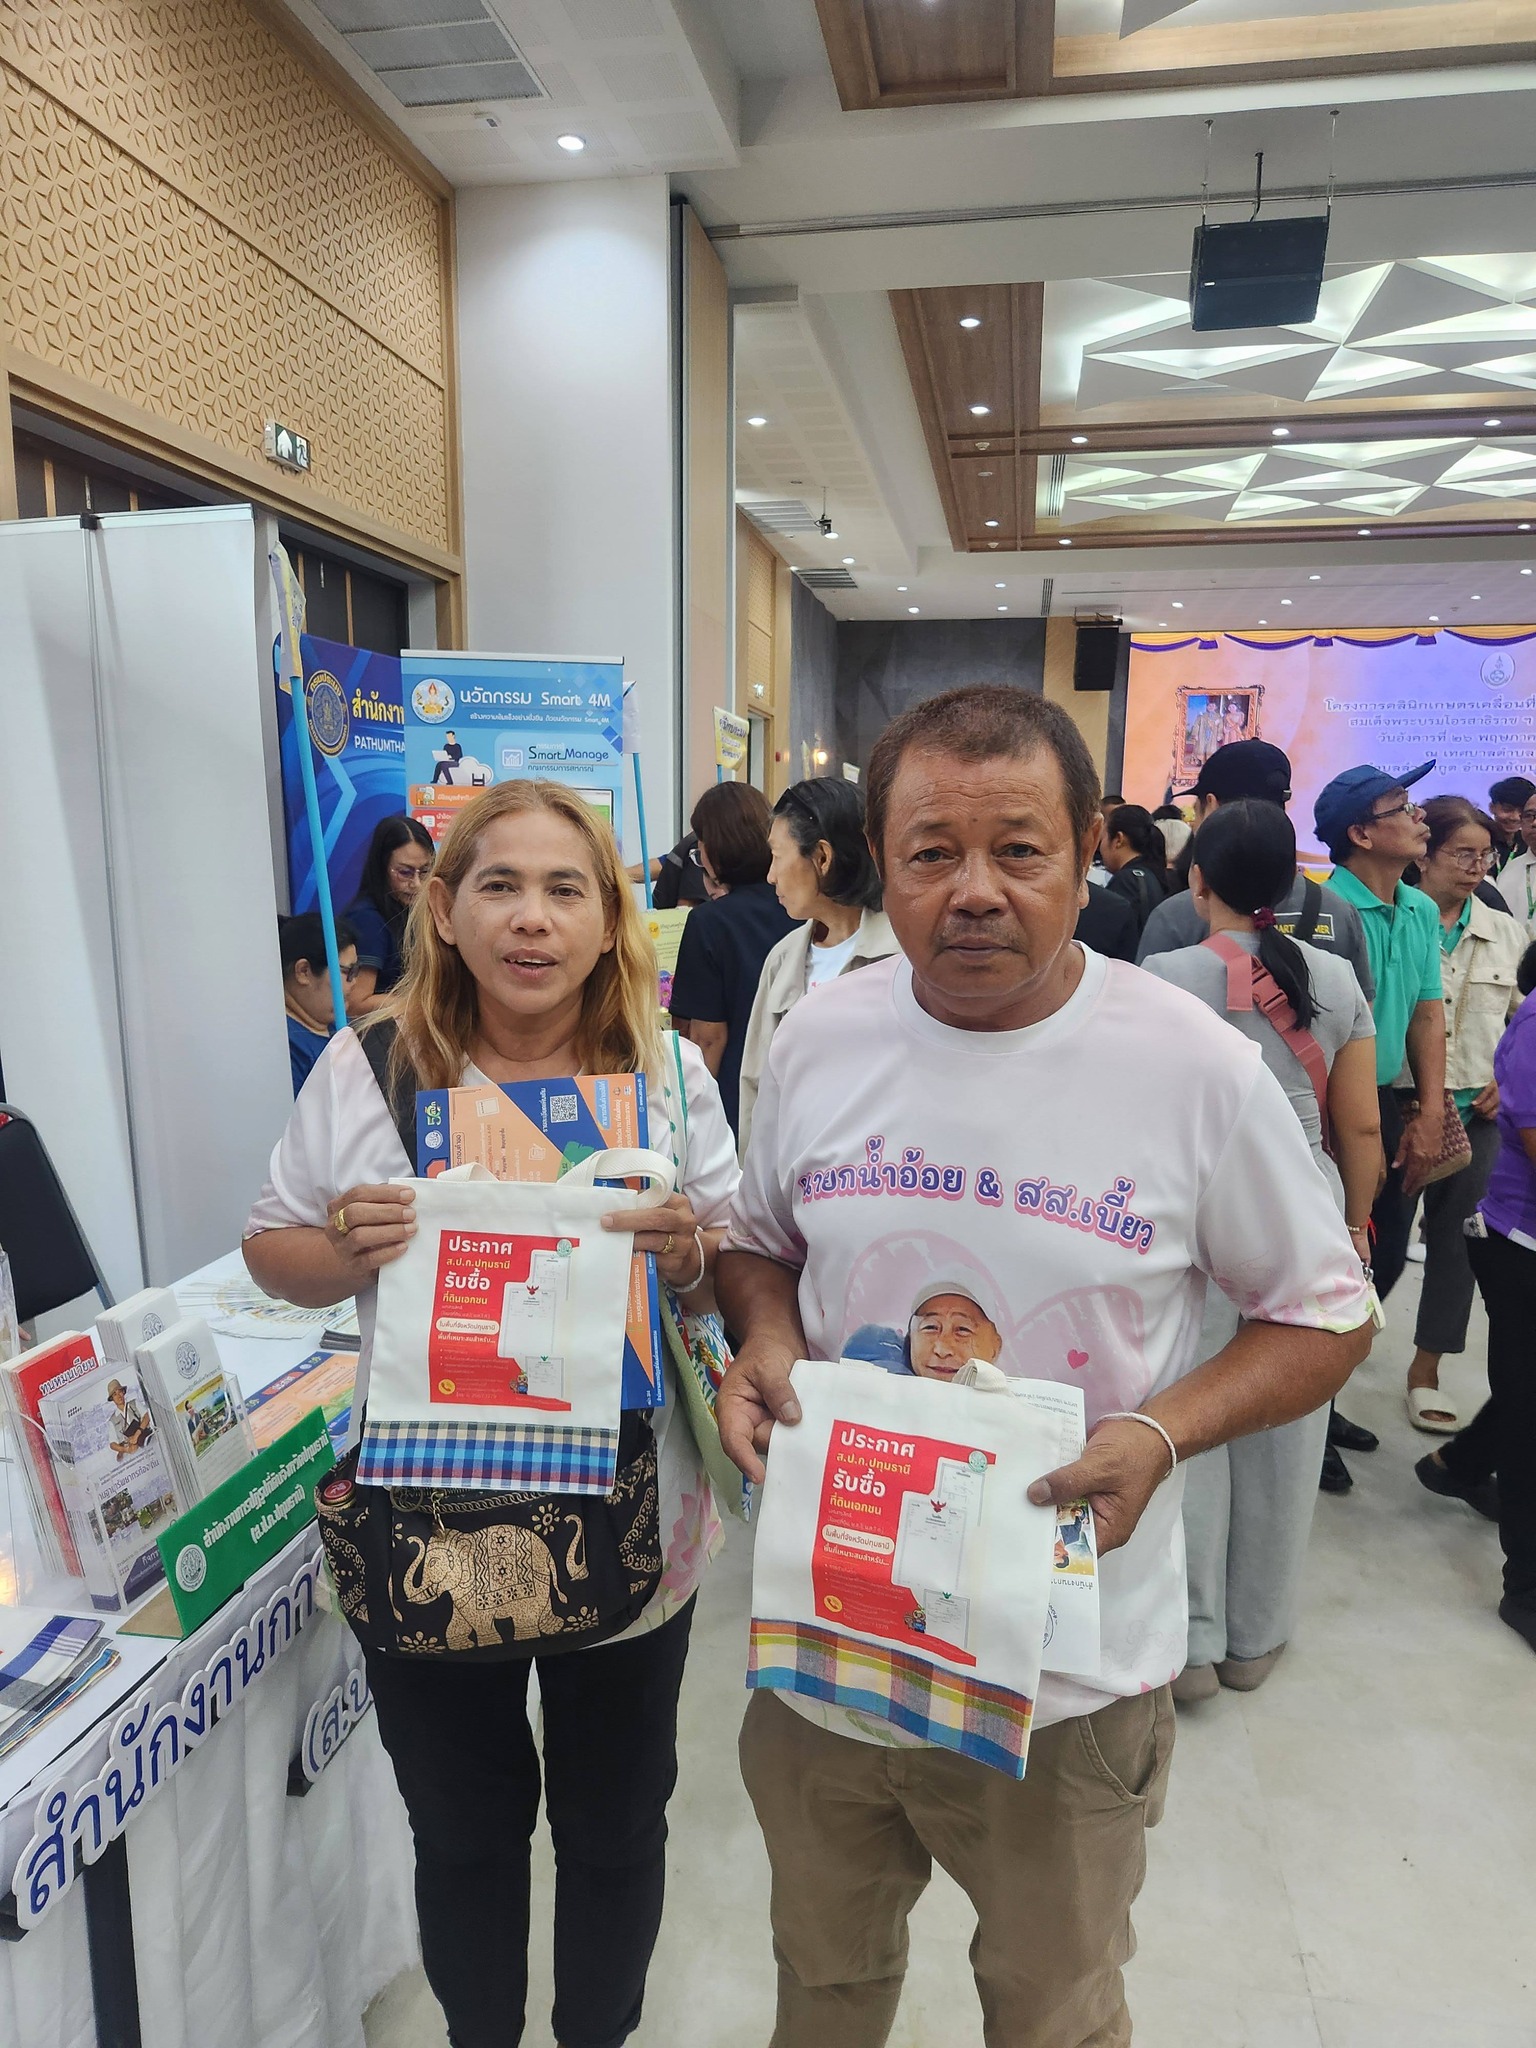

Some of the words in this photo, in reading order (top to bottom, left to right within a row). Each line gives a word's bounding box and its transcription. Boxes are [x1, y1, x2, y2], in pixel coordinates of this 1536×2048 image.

[460, 687, 532, 705] นวัตกรรม
[541, 692, 581, 707] Smart
[588, 693, 611, 708] 4M
[974, 1164, 1004, 1207] &
[1015, 1176, 1156, 1255] สส.เบี้ยว
[448, 1235, 513, 1255] ประกาศ
[446, 1258, 511, 1270] ส.ป.ก.ปทุมธานี
[444, 1267, 491, 1291] รับซื้อ
[442, 1291, 488, 1305] ที่ดินเอกชน
[841, 1428, 915, 1458] ประกาศ
[836, 1452, 912, 1475] ส.ป.ก.ปทุมธานี
[832, 1467, 886, 1498] รับซื้อ
[829, 1492, 883, 1516] ที่ดินเอกชน
[825, 1527, 890, 1551] ในพื้นที่จังหวัดปทุมธานี
